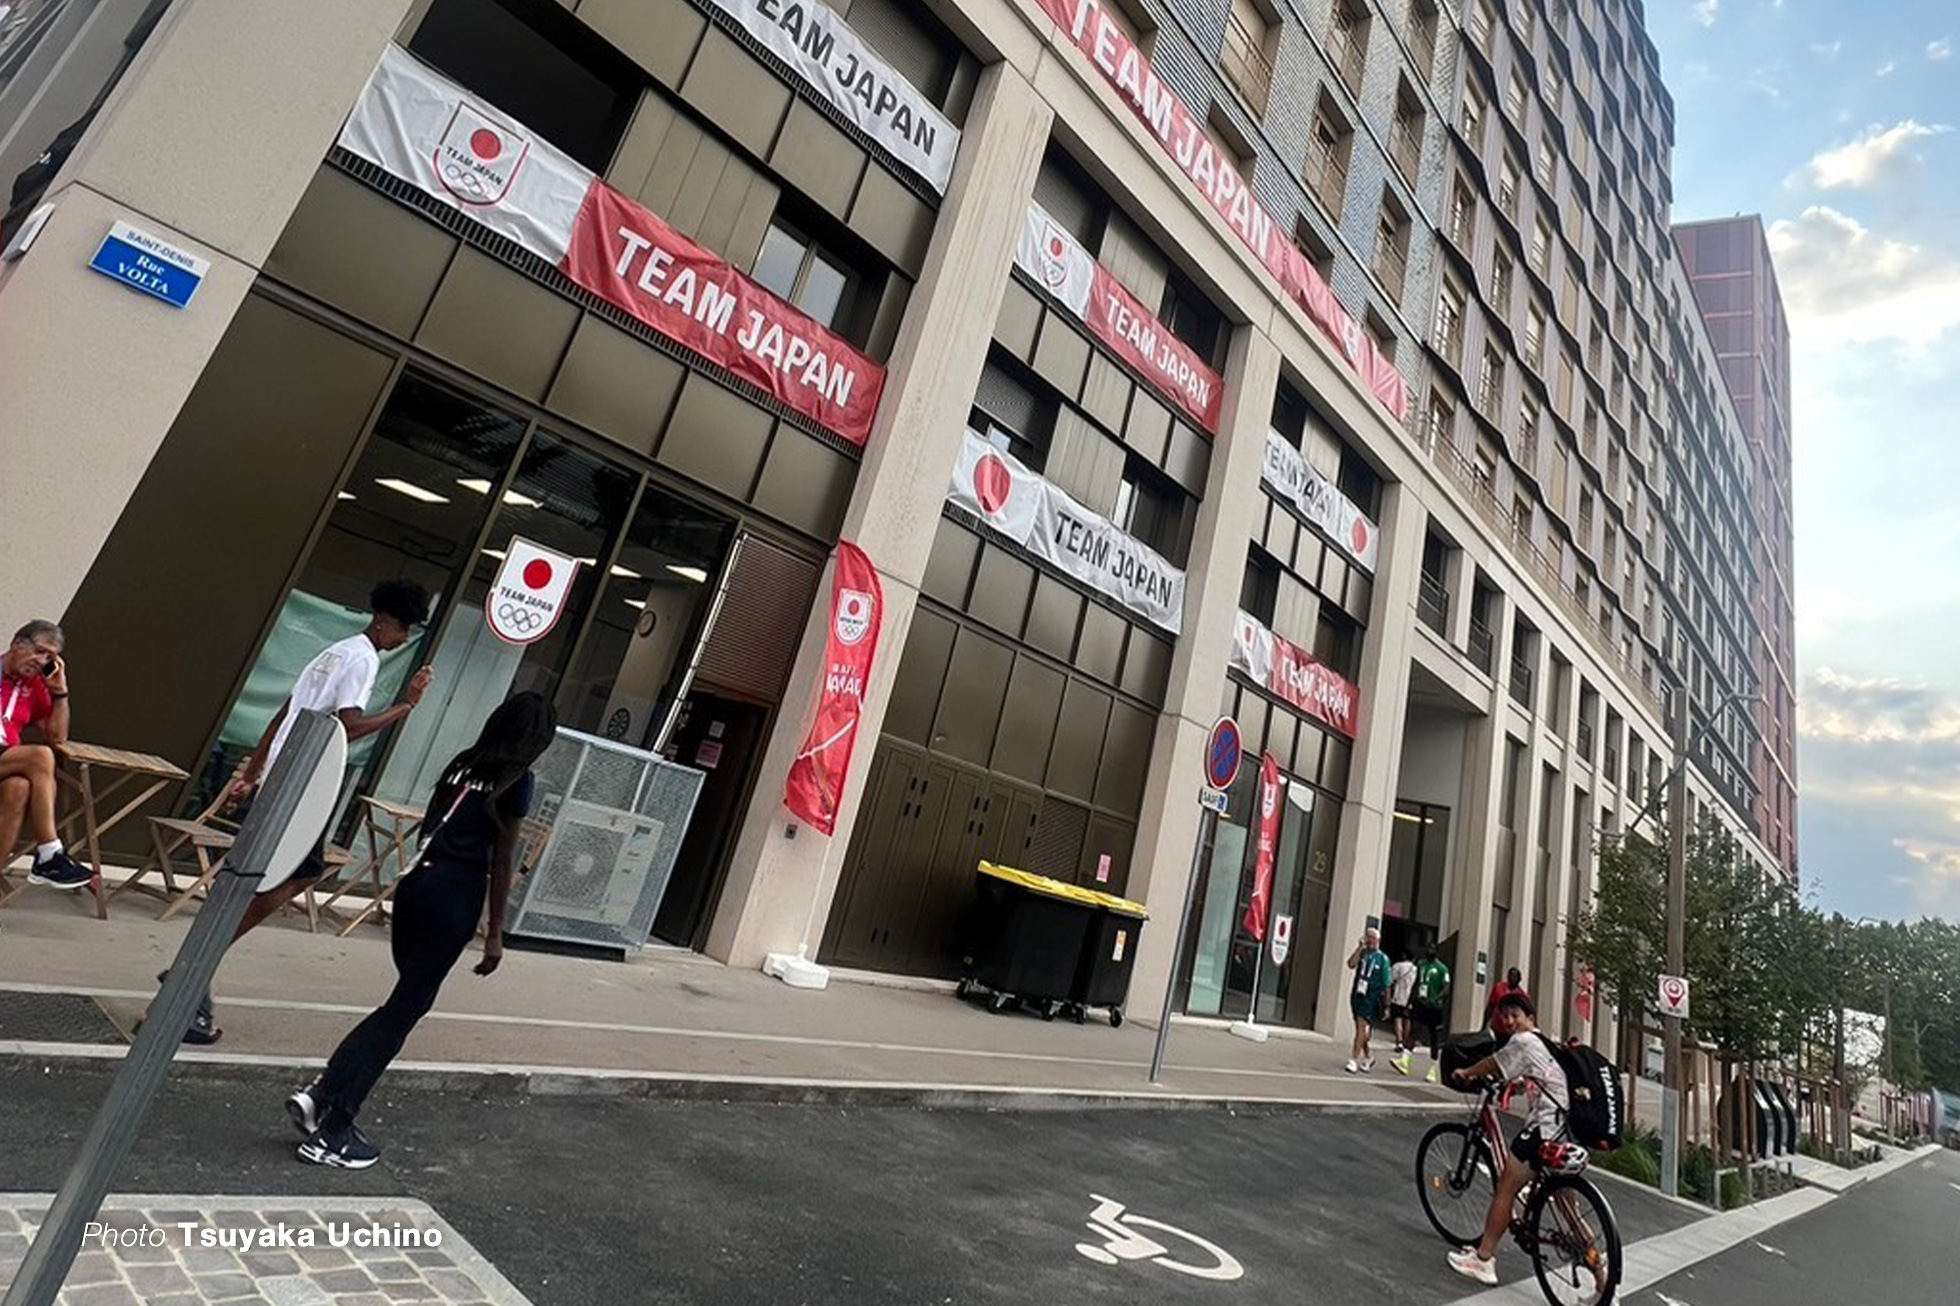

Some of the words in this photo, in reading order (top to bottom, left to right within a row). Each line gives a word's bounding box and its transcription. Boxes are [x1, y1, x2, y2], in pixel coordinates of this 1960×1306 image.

[835, 53, 938, 156] JAPAN
[1071, 0, 1173, 141] TEAM
[1173, 115, 1271, 259] JAPAN
[446, 146, 474, 167] TEAM
[472, 163, 503, 186] JAPAN
[125, 230, 195, 268] SAINT-DENIS
[136, 254, 166, 276] Rue
[117, 262, 169, 295] VOLTA
[618, 226, 737, 336] TEAM
[737, 310, 855, 408] JAPAN
[1107, 293, 1157, 361] TEAM
[1157, 344, 1211, 408] JAPAN
[1055, 510, 1110, 571] TEAM
[1112, 549, 1173, 608] JAPAN
[500, 586, 526, 602] TEAM
[524, 595, 553, 612] JAPAN
[1599, 1066, 1615, 1097] TEAM
